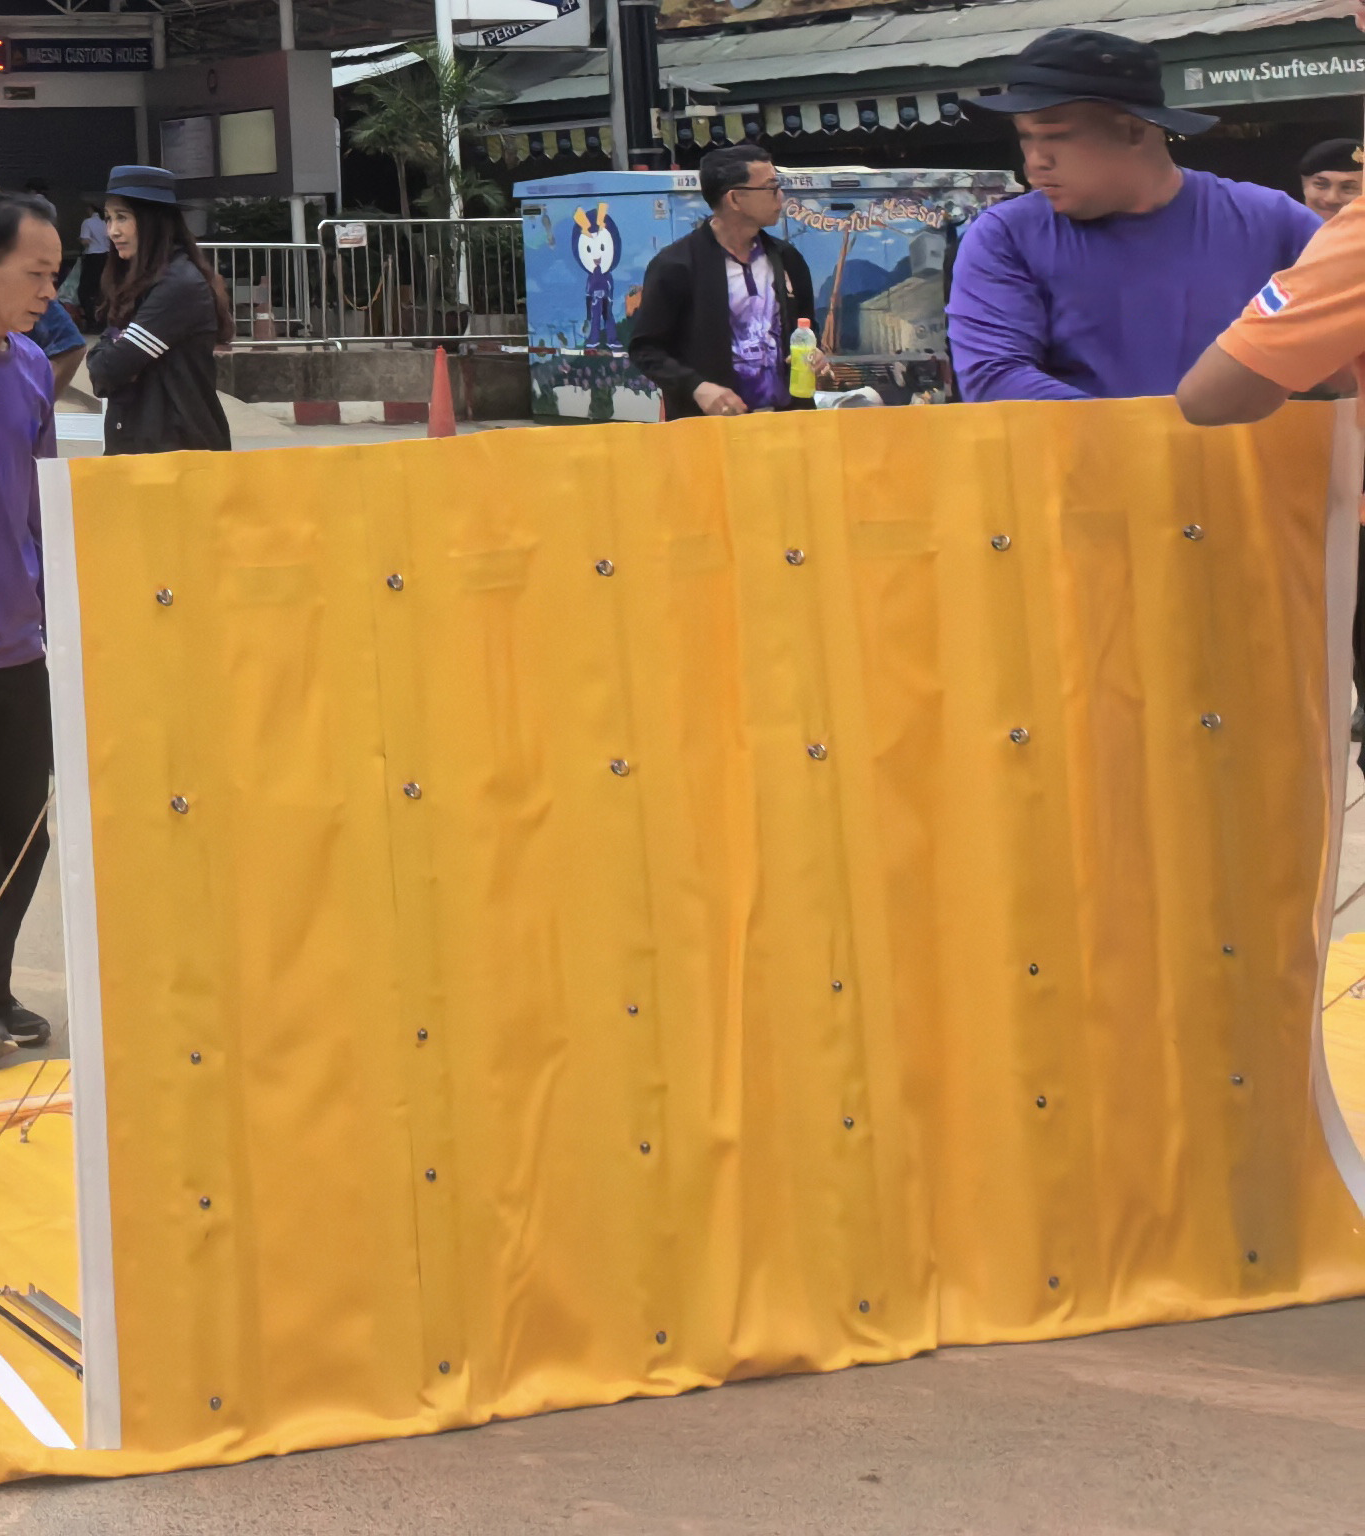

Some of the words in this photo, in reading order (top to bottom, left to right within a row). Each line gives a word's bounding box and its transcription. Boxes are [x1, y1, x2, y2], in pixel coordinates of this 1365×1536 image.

[65, 47, 113, 64] CUSTOMS
[116, 47, 149, 64] HOUSE
[784, 201, 876, 233] onderful
